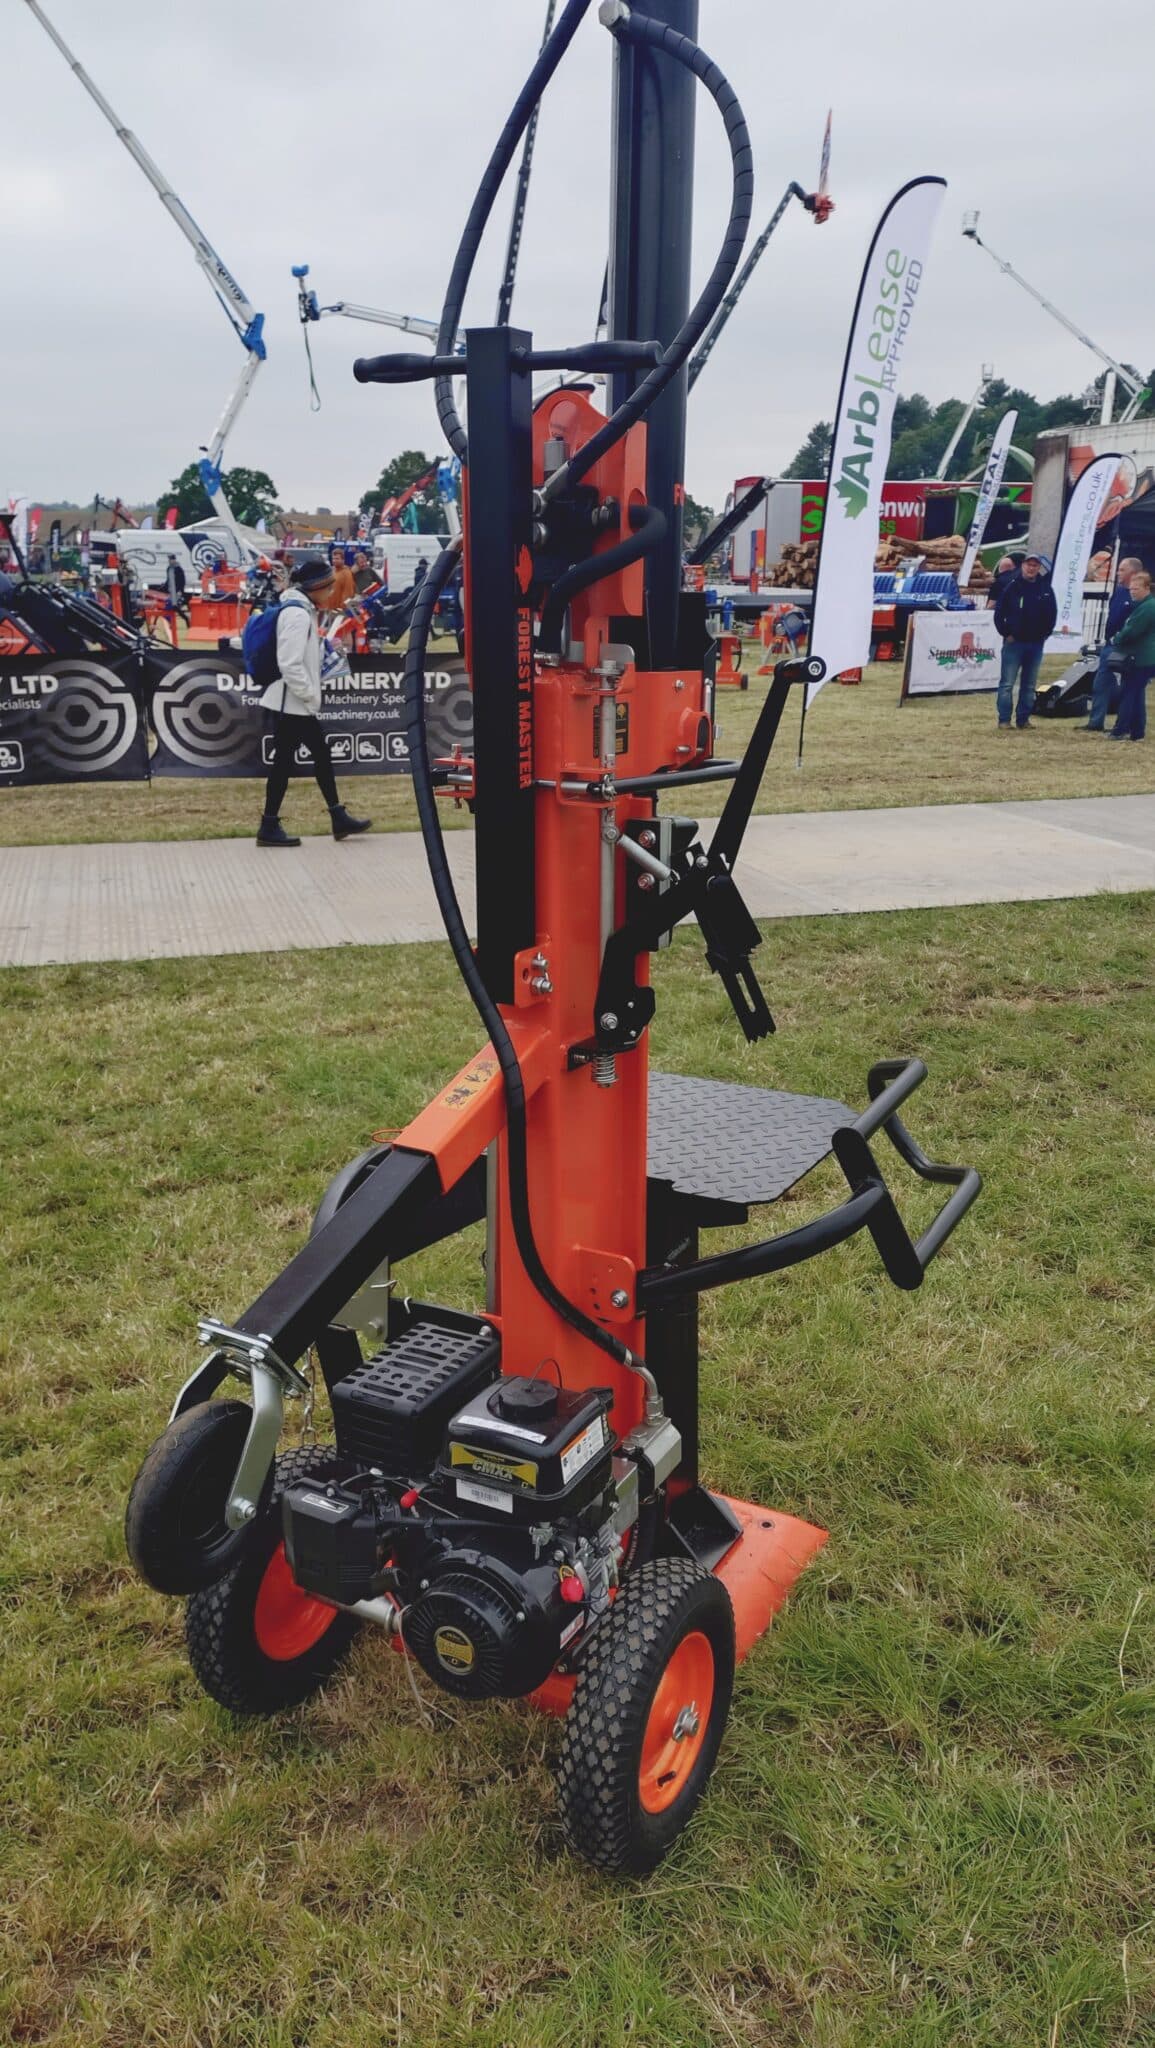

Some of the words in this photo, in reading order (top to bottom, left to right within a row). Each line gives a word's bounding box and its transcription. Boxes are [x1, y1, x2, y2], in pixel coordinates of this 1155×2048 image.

[881, 258, 923, 394] APPROVED
[10, 675, 59, 695] LTD
[518, 607, 531, 693] FOREST
[325, 693, 379, 706] Machinery
[518, 701, 532, 789] MASTER
